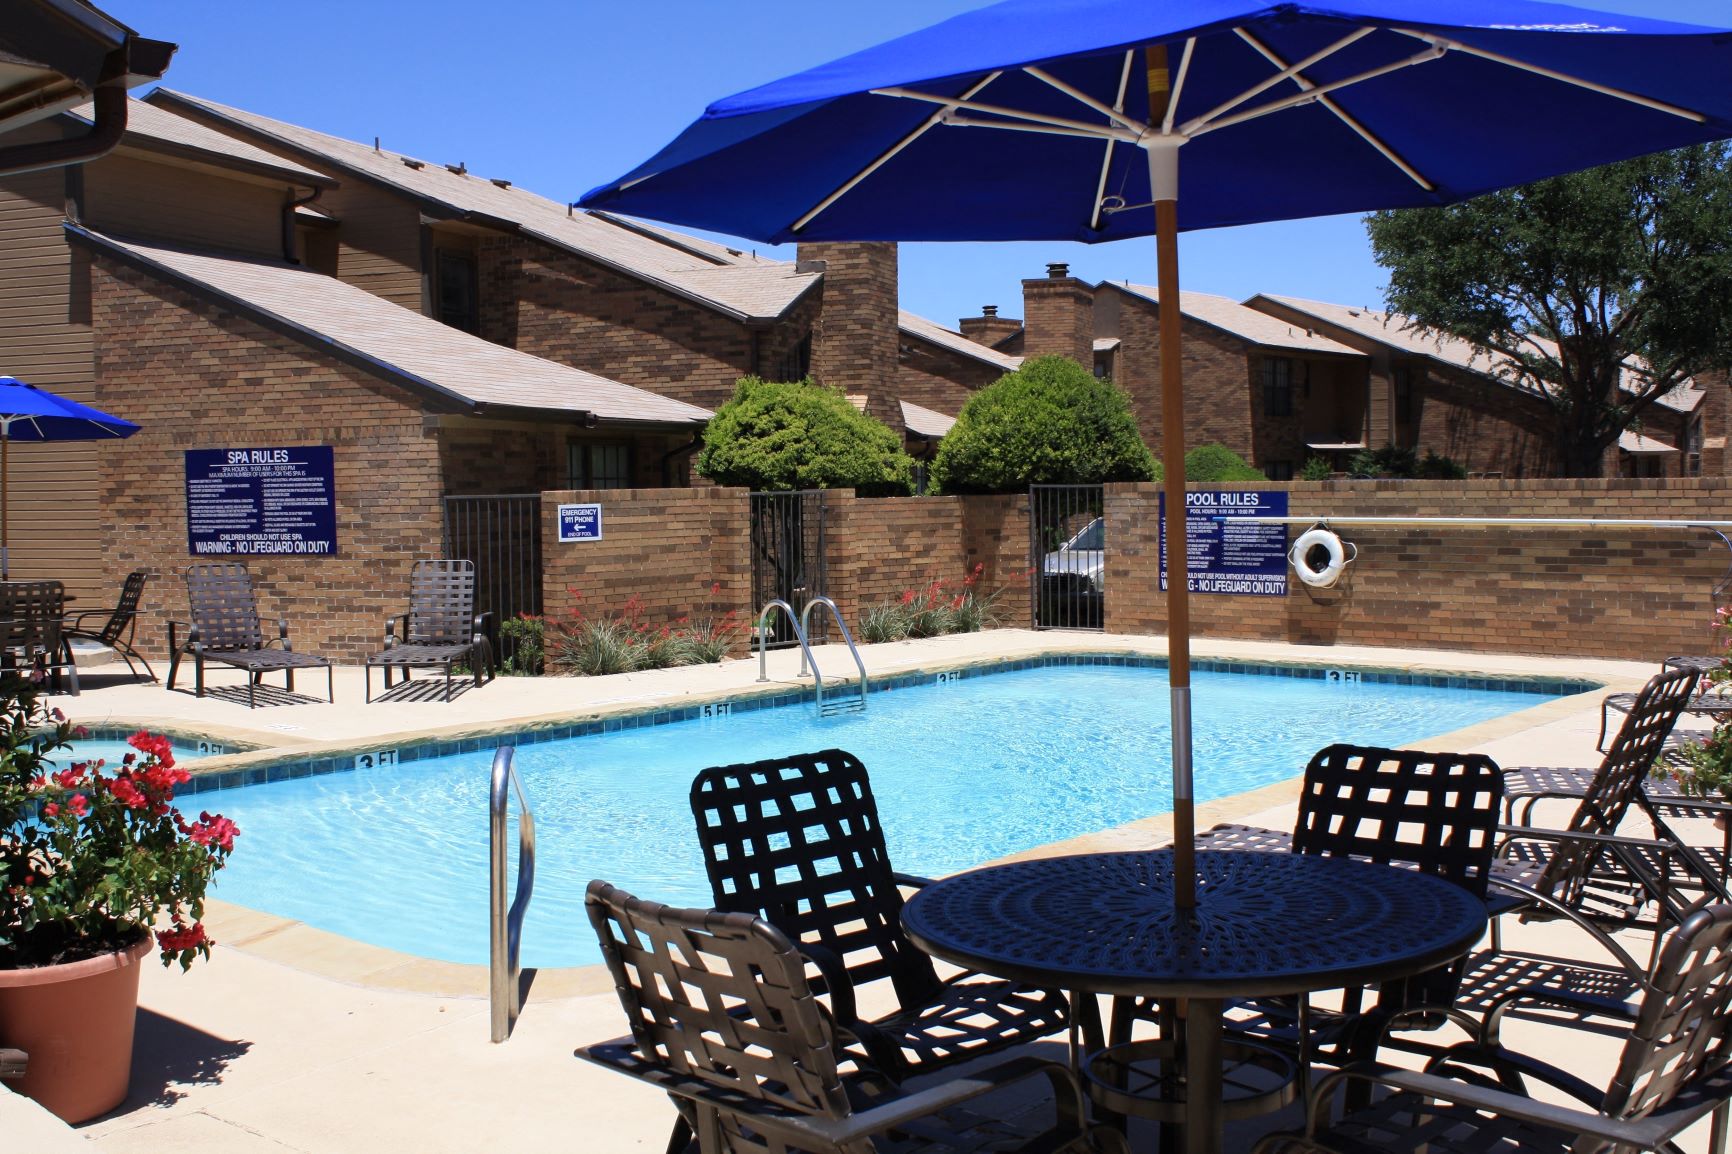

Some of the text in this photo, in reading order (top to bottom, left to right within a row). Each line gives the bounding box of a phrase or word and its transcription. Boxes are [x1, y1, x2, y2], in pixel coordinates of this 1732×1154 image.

[228, 450, 288, 464] SPA RULES
[1187, 493, 1258, 505] POOL RULES
[196, 542, 231, 553] WARNING
[237, 542, 248, 553] NO
[250, 541, 293, 553] LIFEGUARD
[295, 541, 306, 552] ON
[308, 541, 329, 552] DUTY
[1199, 580, 1210, 591] NO
[1211, 580, 1251, 592] LIFEGUARD
[1253, 582, 1263, 593] ON
[1265, 582, 1285, 594] DUTY
[949, 672, 958, 680] FT
[1345, 672, 1359, 681] FT
[705, 704, 729, 717] 5 FT
[212, 744, 223, 754] FT
[379, 749, 396, 765] FT
